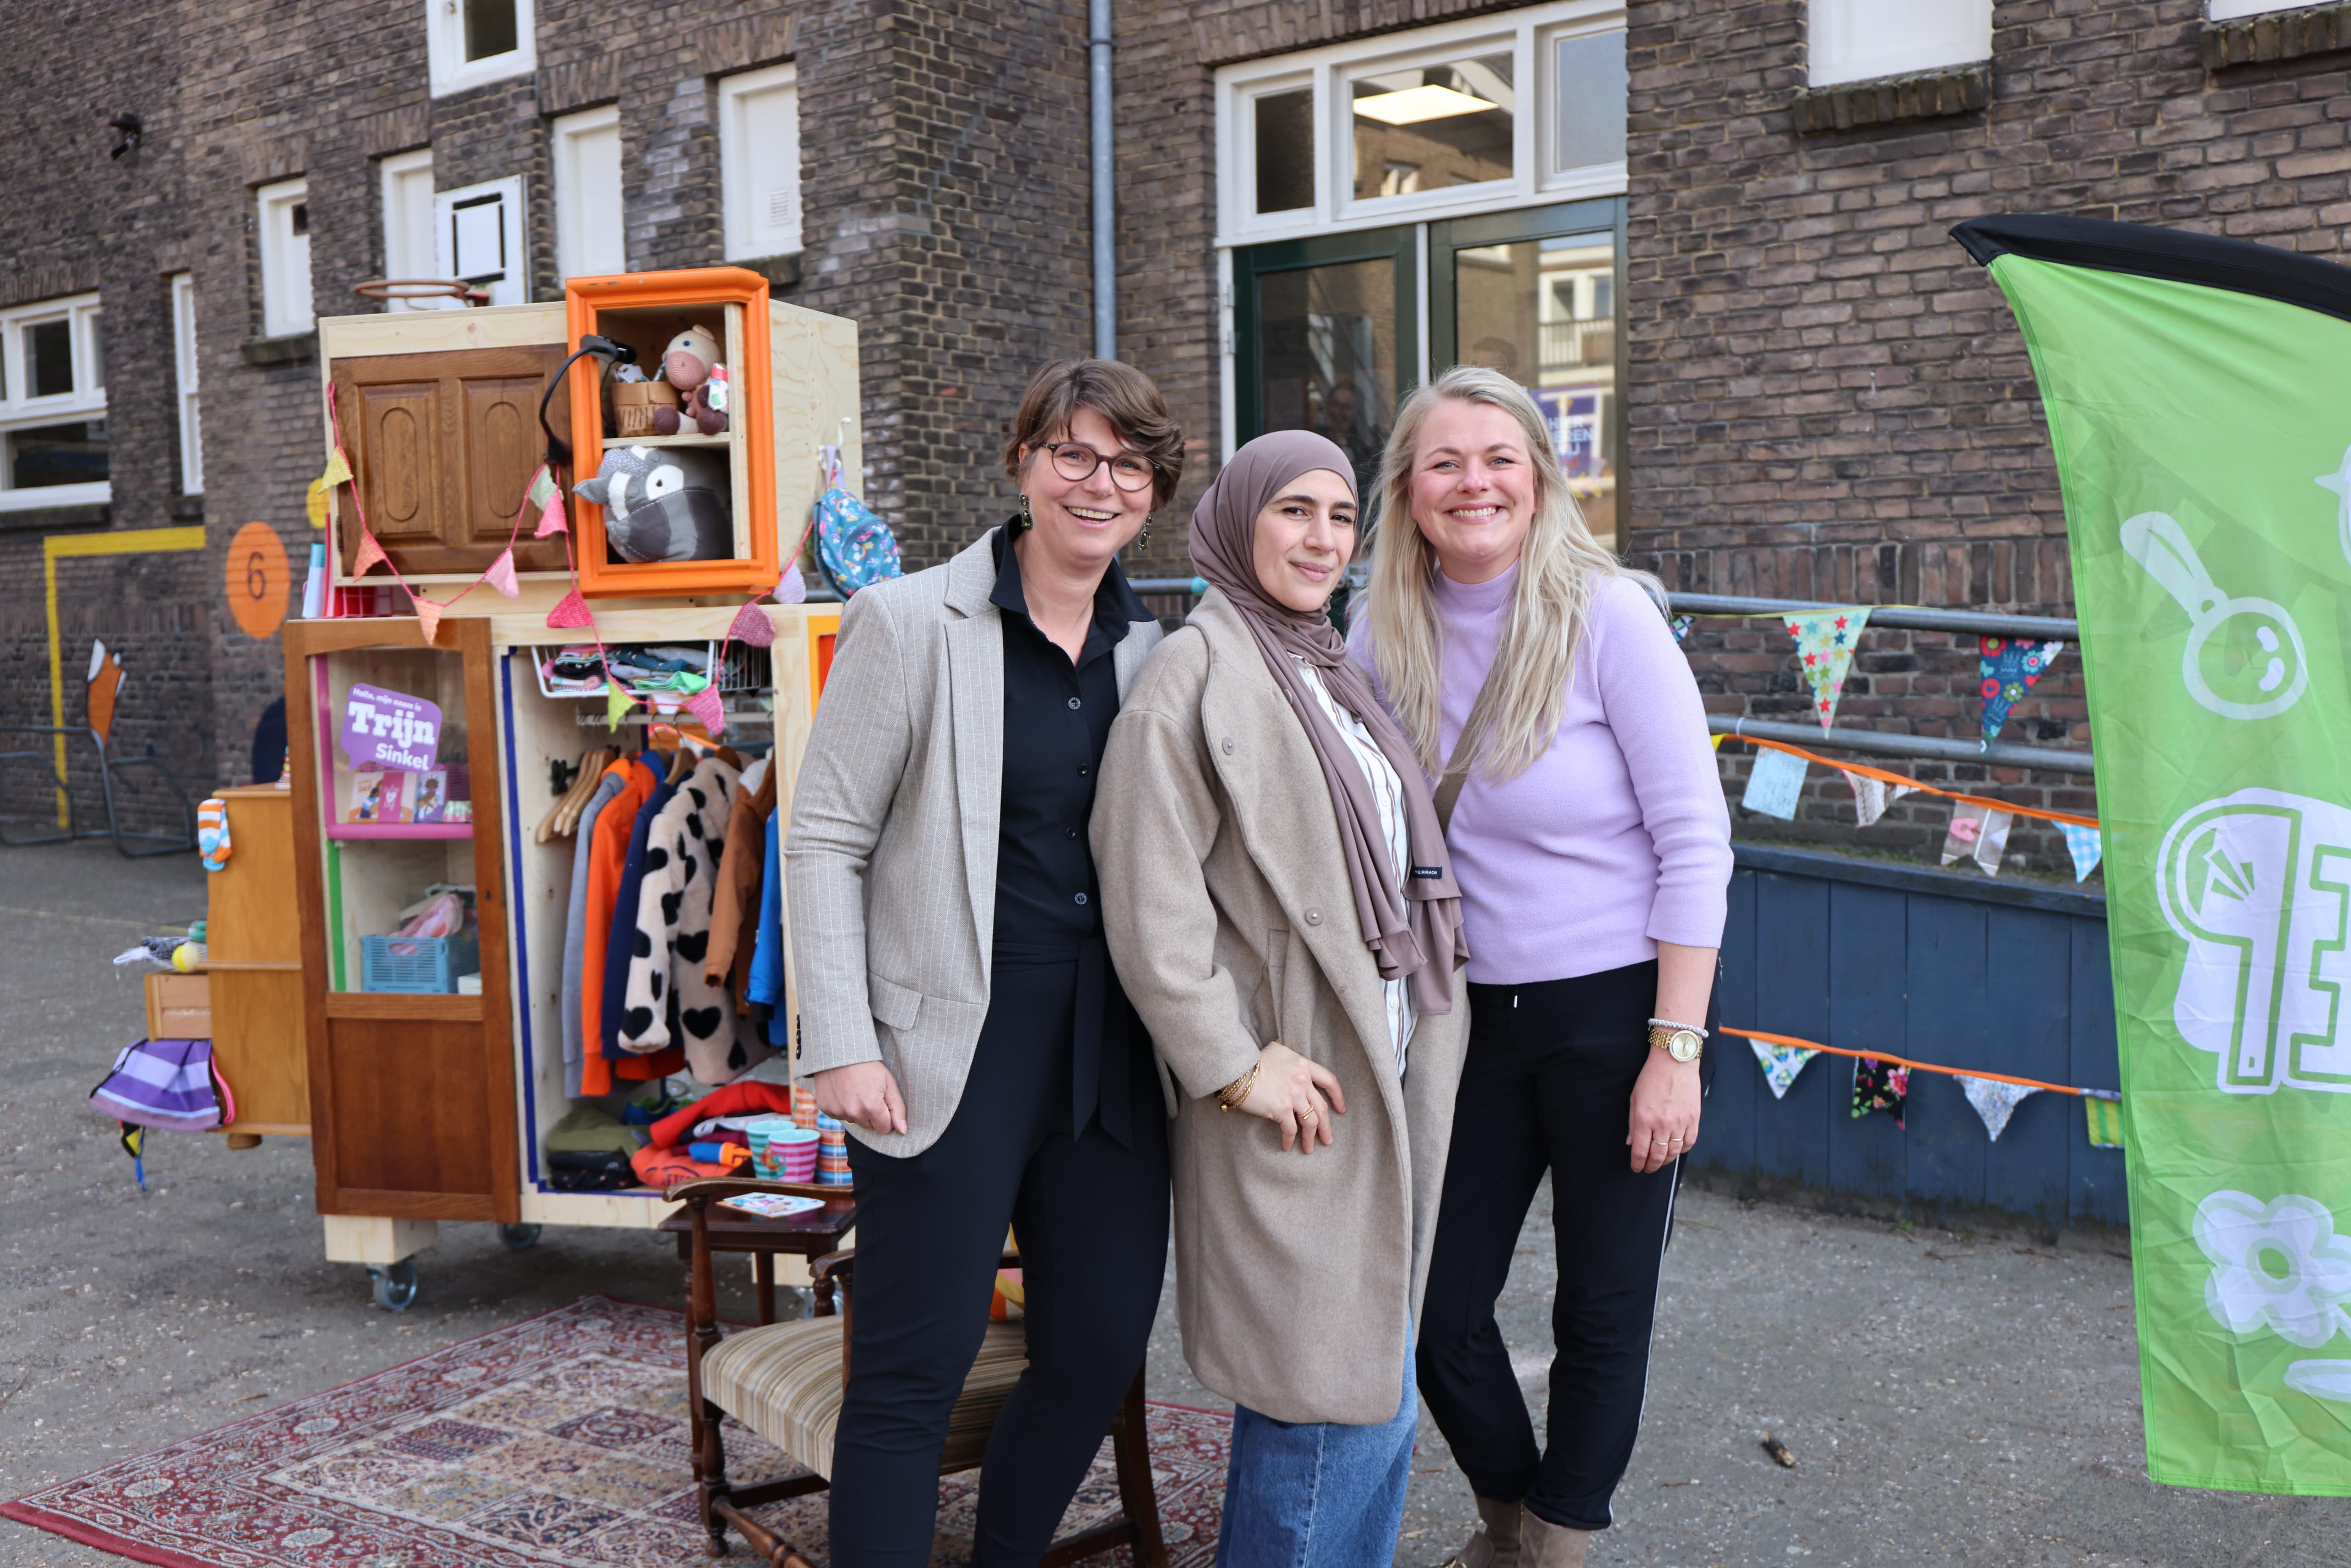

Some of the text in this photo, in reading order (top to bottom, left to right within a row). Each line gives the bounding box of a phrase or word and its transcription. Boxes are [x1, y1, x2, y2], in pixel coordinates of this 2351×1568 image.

[247, 551, 266, 601] 6
[353, 688, 422, 712] Hallo, mijn naam is
[348, 701, 435, 748] Trijn
[375, 742, 429, 771] Sinkel
